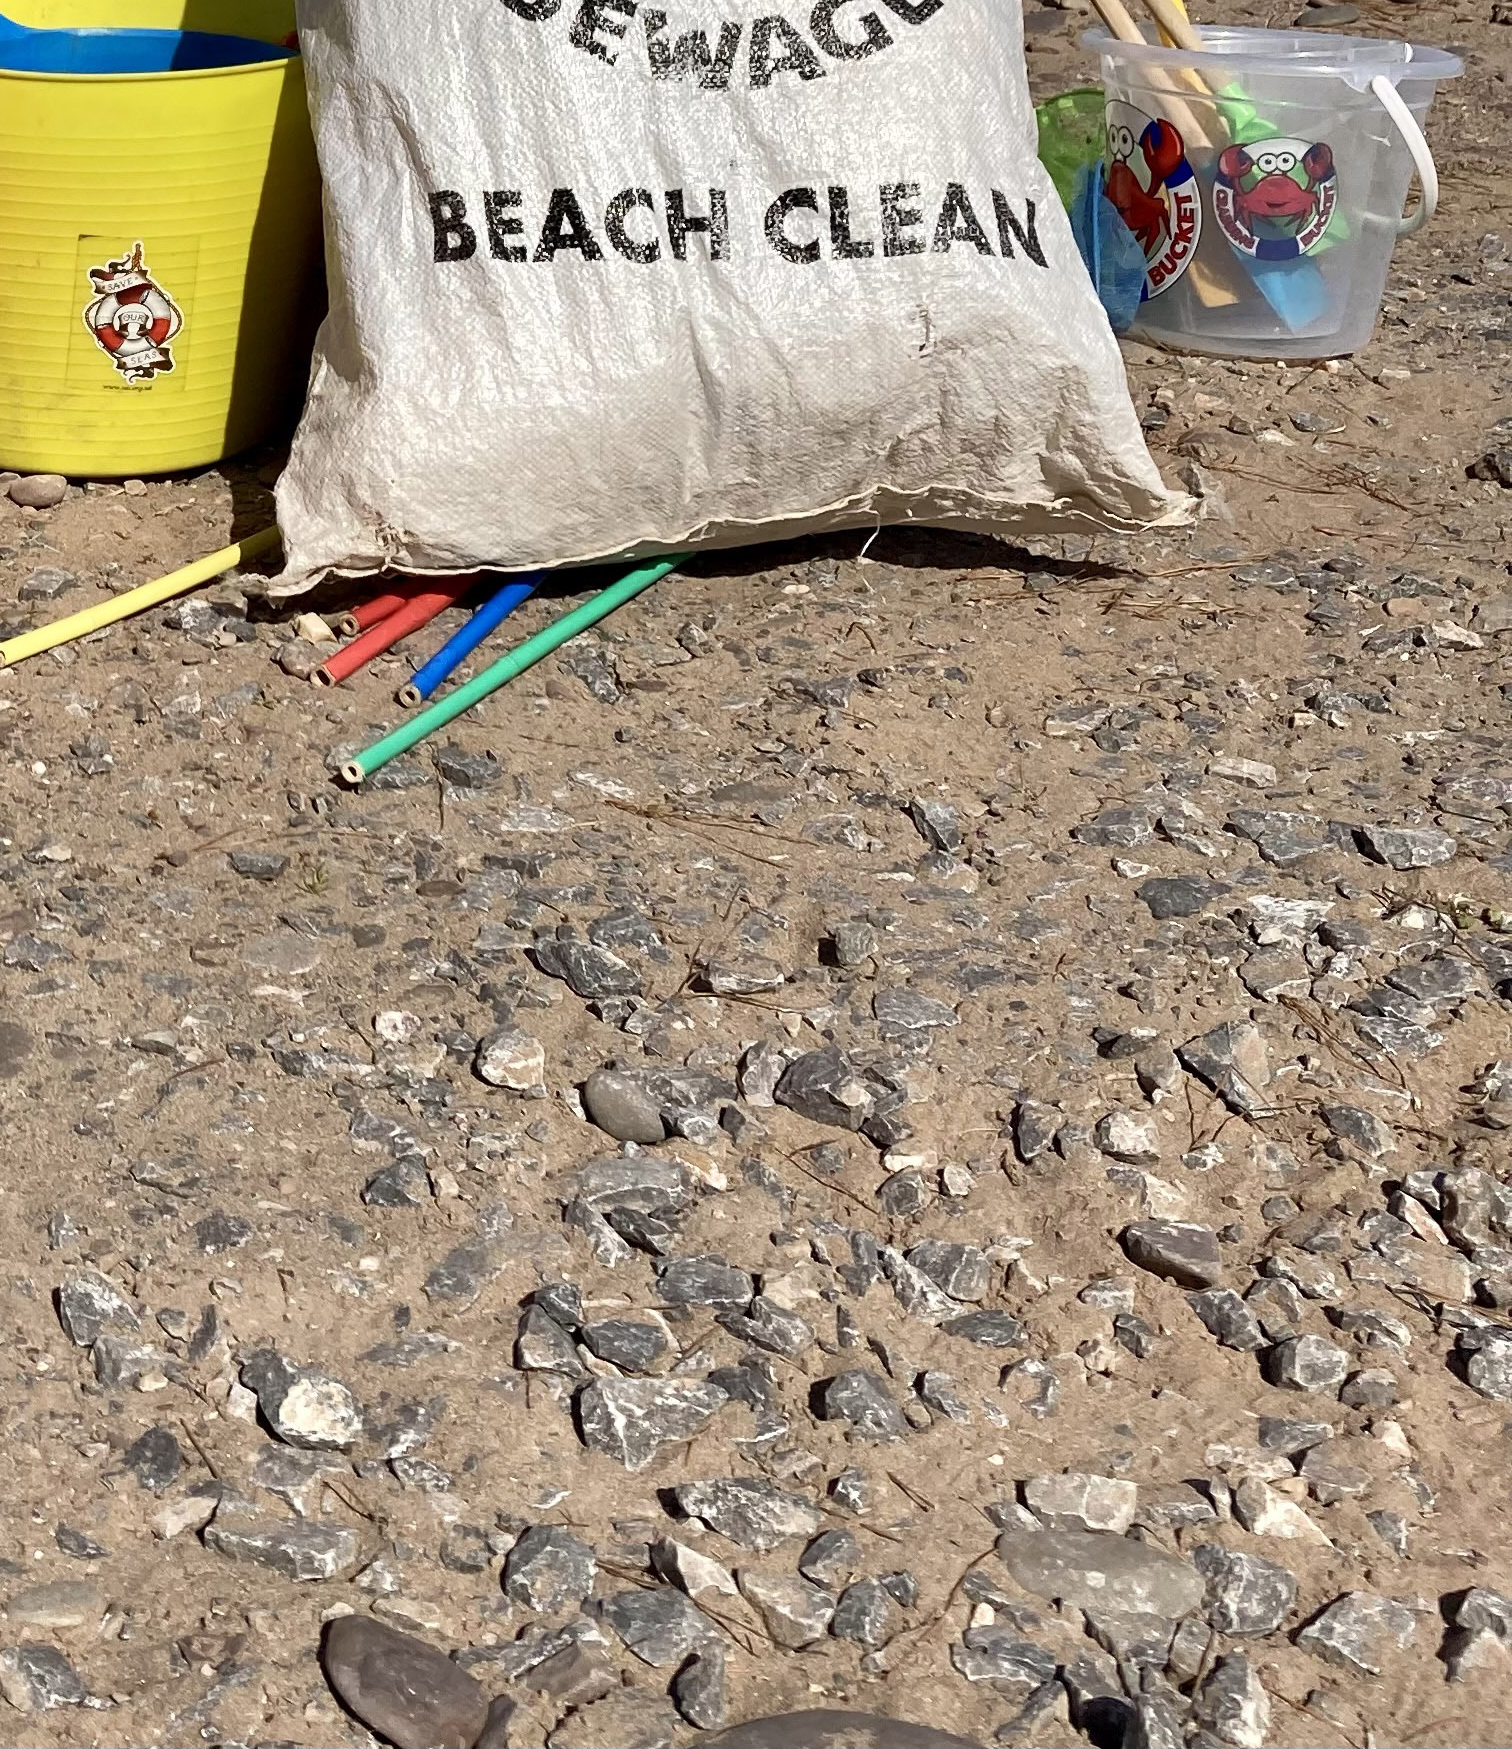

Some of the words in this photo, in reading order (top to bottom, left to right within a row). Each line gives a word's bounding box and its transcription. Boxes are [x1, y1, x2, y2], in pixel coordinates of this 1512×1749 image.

[429, 186, 730, 264] BEACH
[764, 180, 1050, 269] CLEAN
[1148, 192, 1194, 286] BUCKET
[108, 278, 134, 290] SAVE
[123, 313, 145, 323] OUR
[130, 350, 157, 365] SEAS
